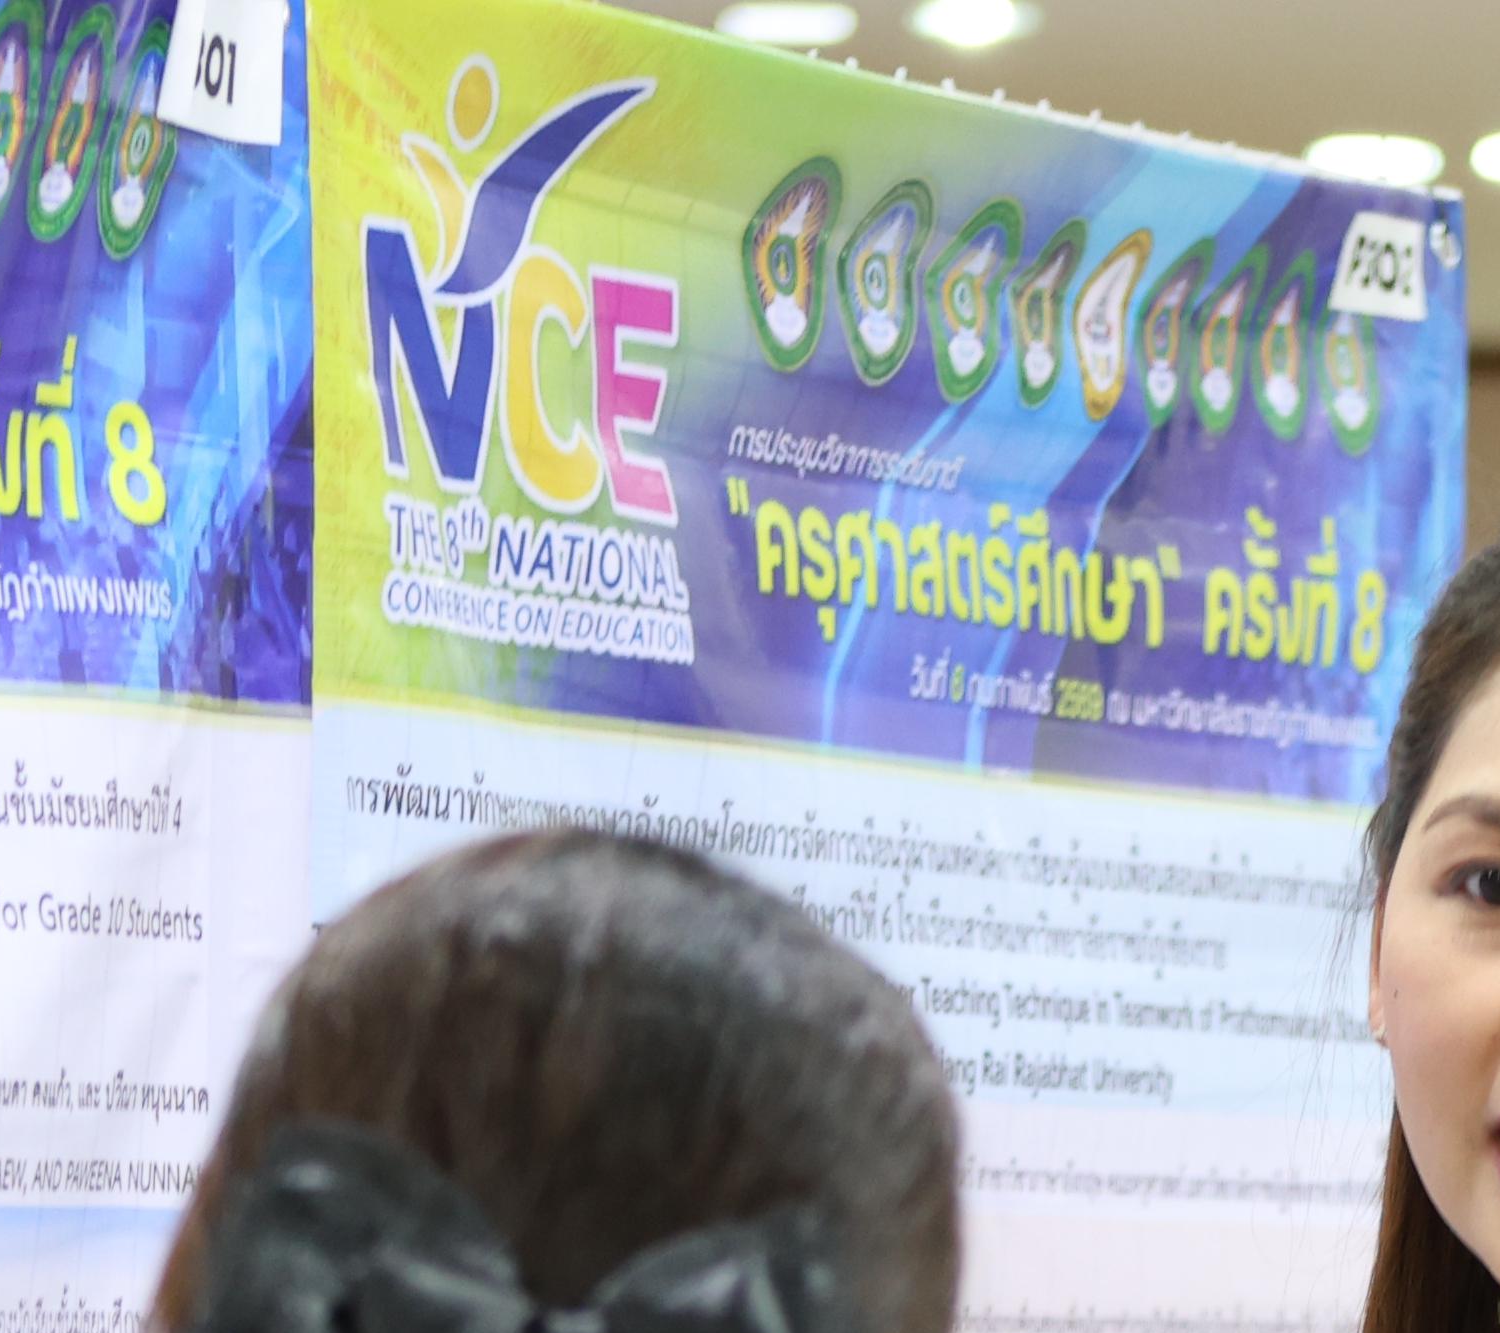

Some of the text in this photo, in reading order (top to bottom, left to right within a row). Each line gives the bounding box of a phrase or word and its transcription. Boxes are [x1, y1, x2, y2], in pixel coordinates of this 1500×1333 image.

[366, 218, 680, 524] NCE
[102, 402, 169, 528] 8
[386, 502, 443, 563] THE
[491, 516, 690, 605] NATIONAL
[1202, 506, 1339, 668] ครั้งที่
[1350, 570, 1387, 674] 8
[386, 579, 512, 641] CONFERENCE
[560, 609, 695, 664] EDUCATION
[37, 892, 102, 938] Grade
[104, 897, 124, 938] 10
[125, 895, 204, 943] Students
[920, 975, 1001, 1029] Teaching
[1004, 983, 1091, 1034] Technique
[1113, 990, 1195, 1032] Teamwork
[981, 1050, 1010, 1089] Rai
[1014, 1051, 1090, 1098] Rajabhat
[1093, 1060, 1173, 1106] University
[32, 1160, 63, 1191] AND
